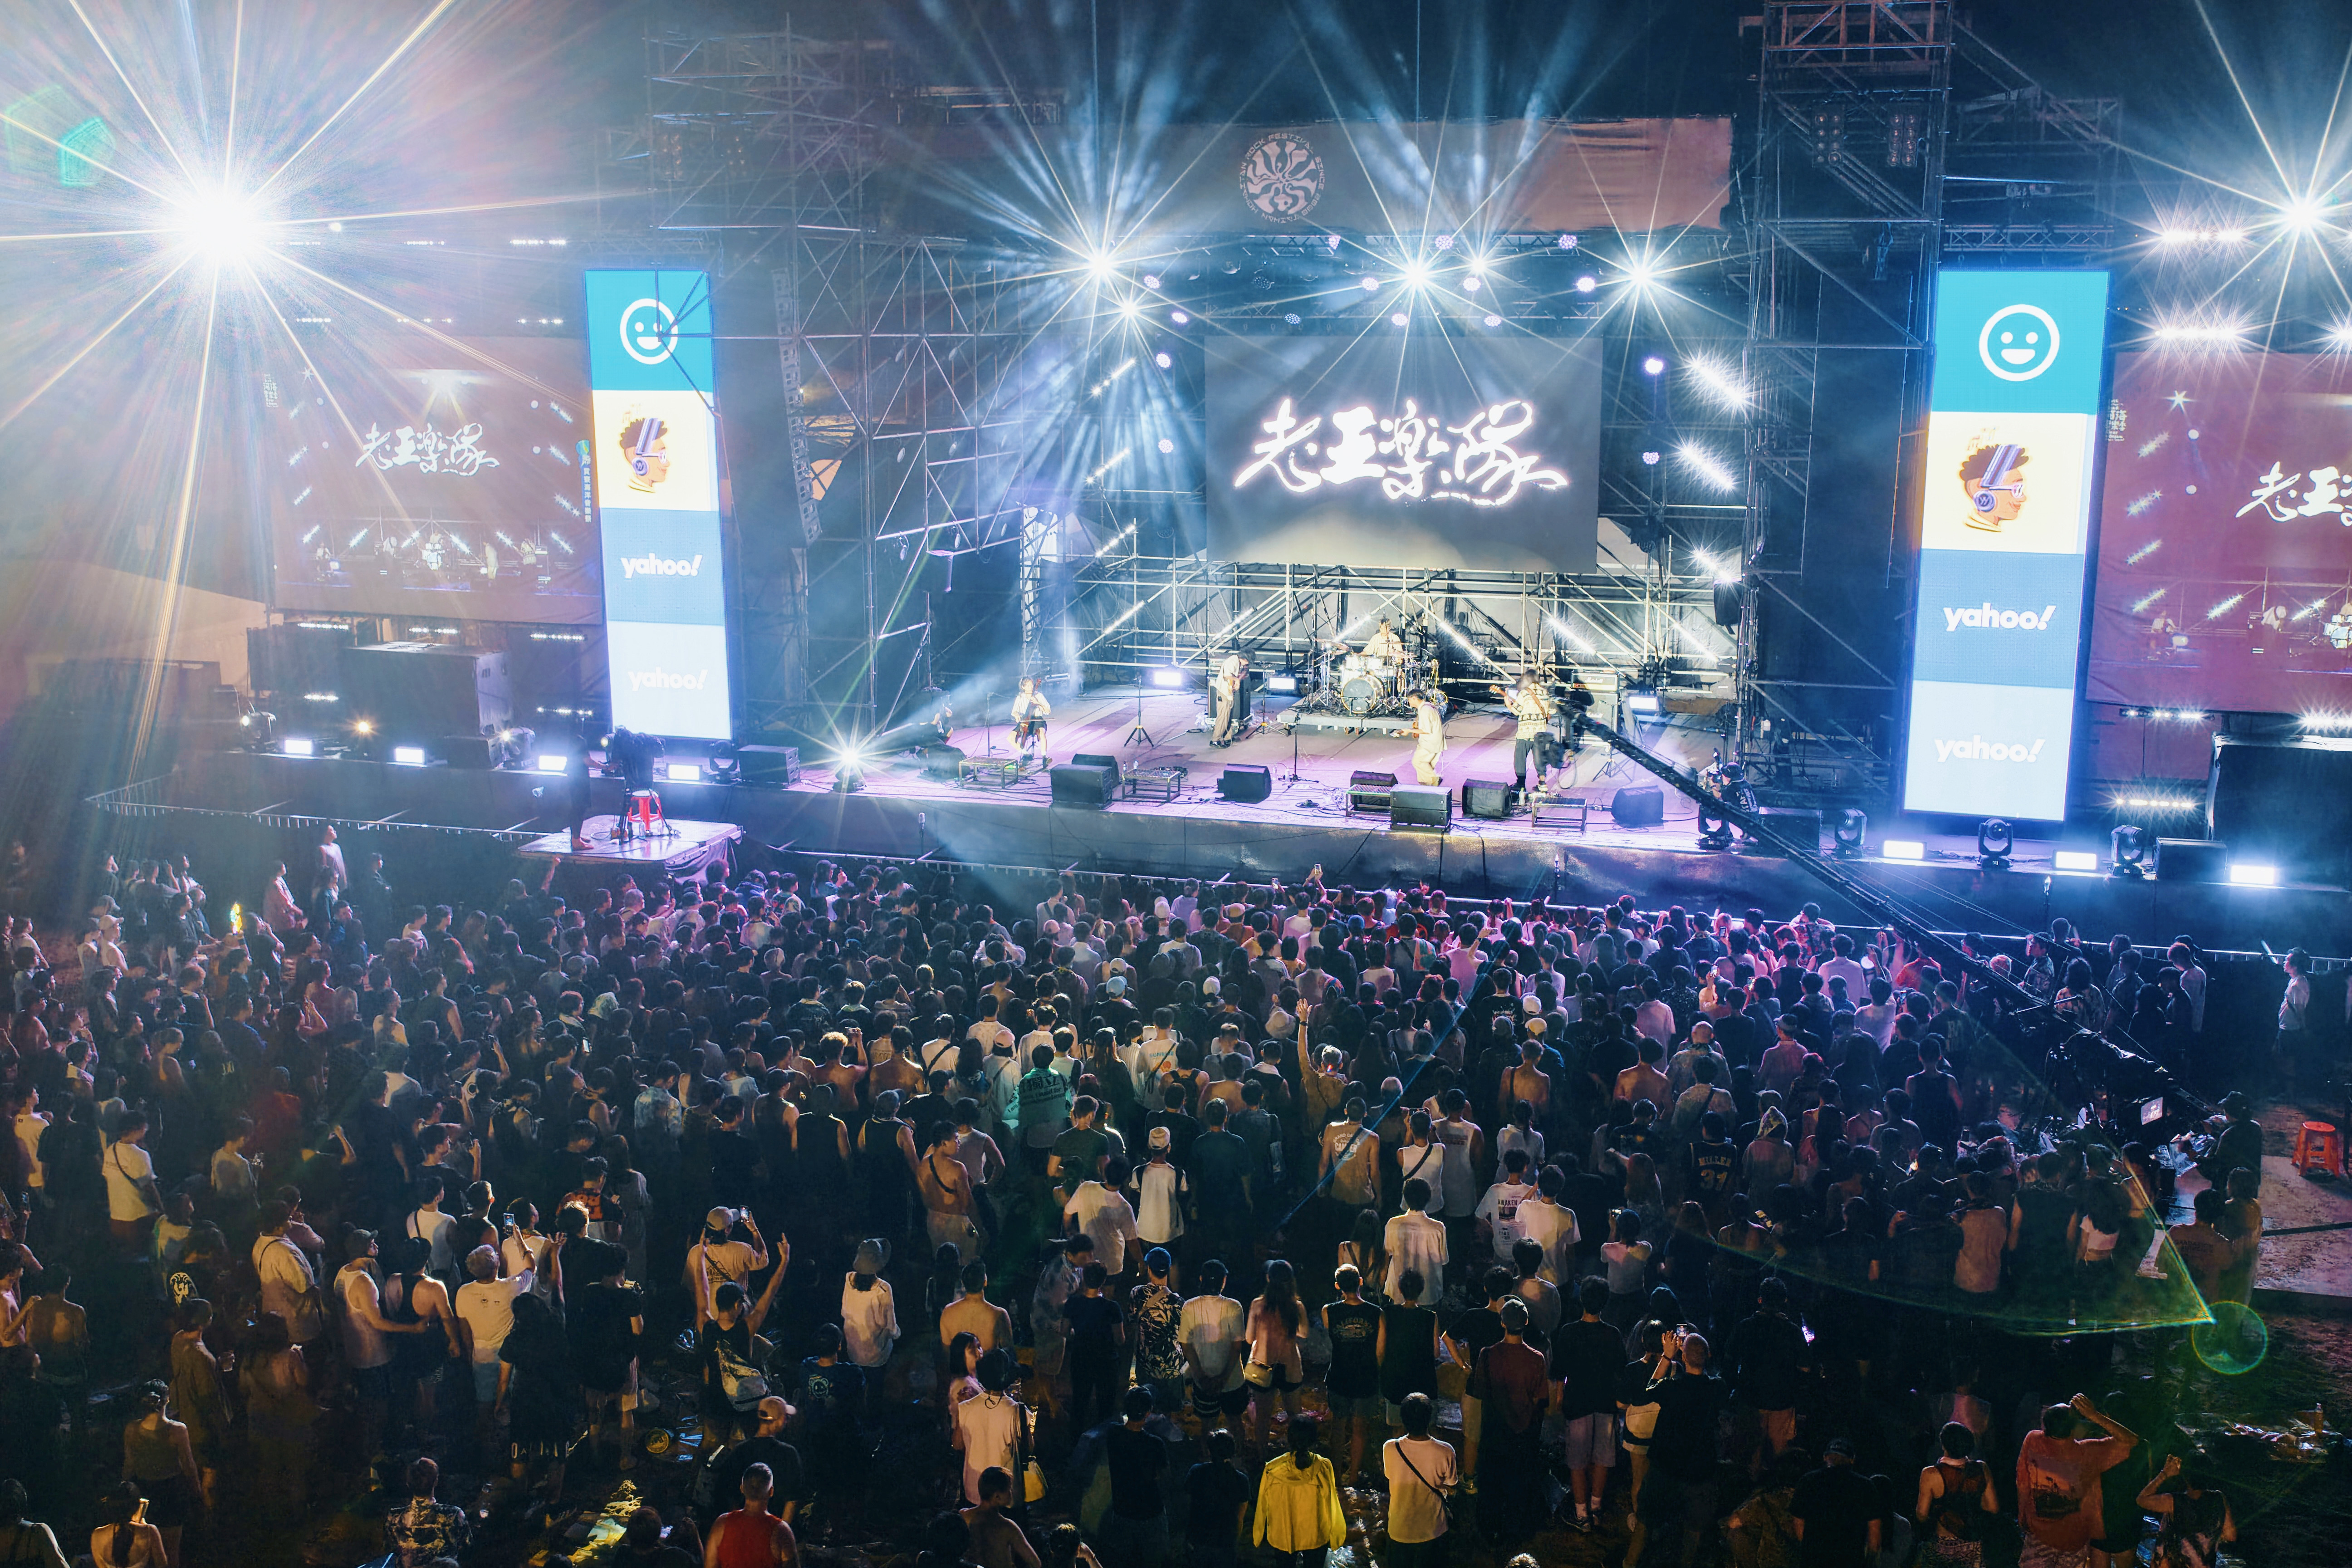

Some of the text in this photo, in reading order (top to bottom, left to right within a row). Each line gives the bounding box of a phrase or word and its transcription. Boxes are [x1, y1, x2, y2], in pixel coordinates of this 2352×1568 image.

[355, 422, 500, 475] 老王樂隊
[1235, 399, 1568, 506] 老王樂隊
[620, 552, 703, 579] yahoo!
[1943, 602, 2057, 632] yahoo!
[627, 666, 708, 691] yahoo!
[1934, 735, 2046, 763] yahoo!
